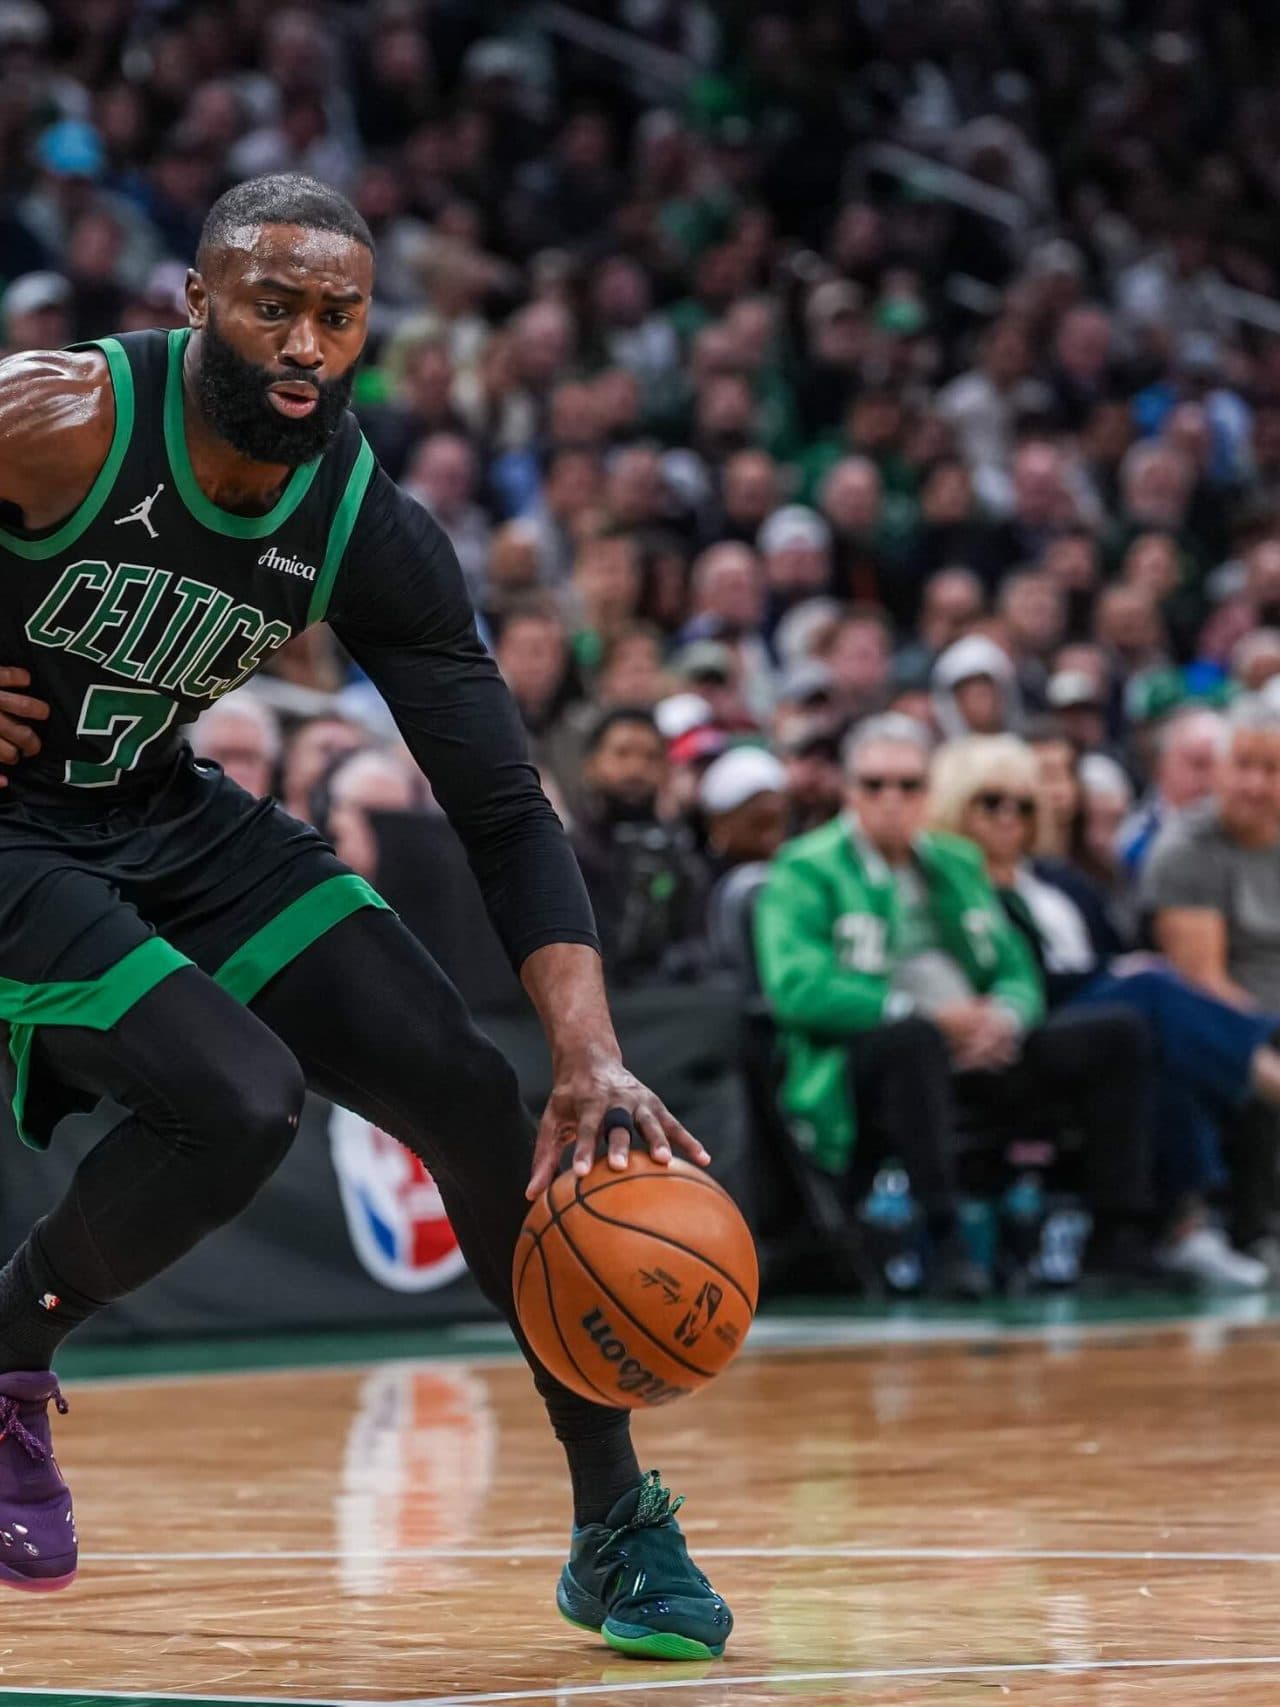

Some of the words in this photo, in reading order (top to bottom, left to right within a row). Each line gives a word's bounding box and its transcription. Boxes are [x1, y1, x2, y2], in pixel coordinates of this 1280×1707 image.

[258, 547, 316, 581] Amica
[24, 559, 292, 700] CELTICS
[63, 684, 179, 788] 7
